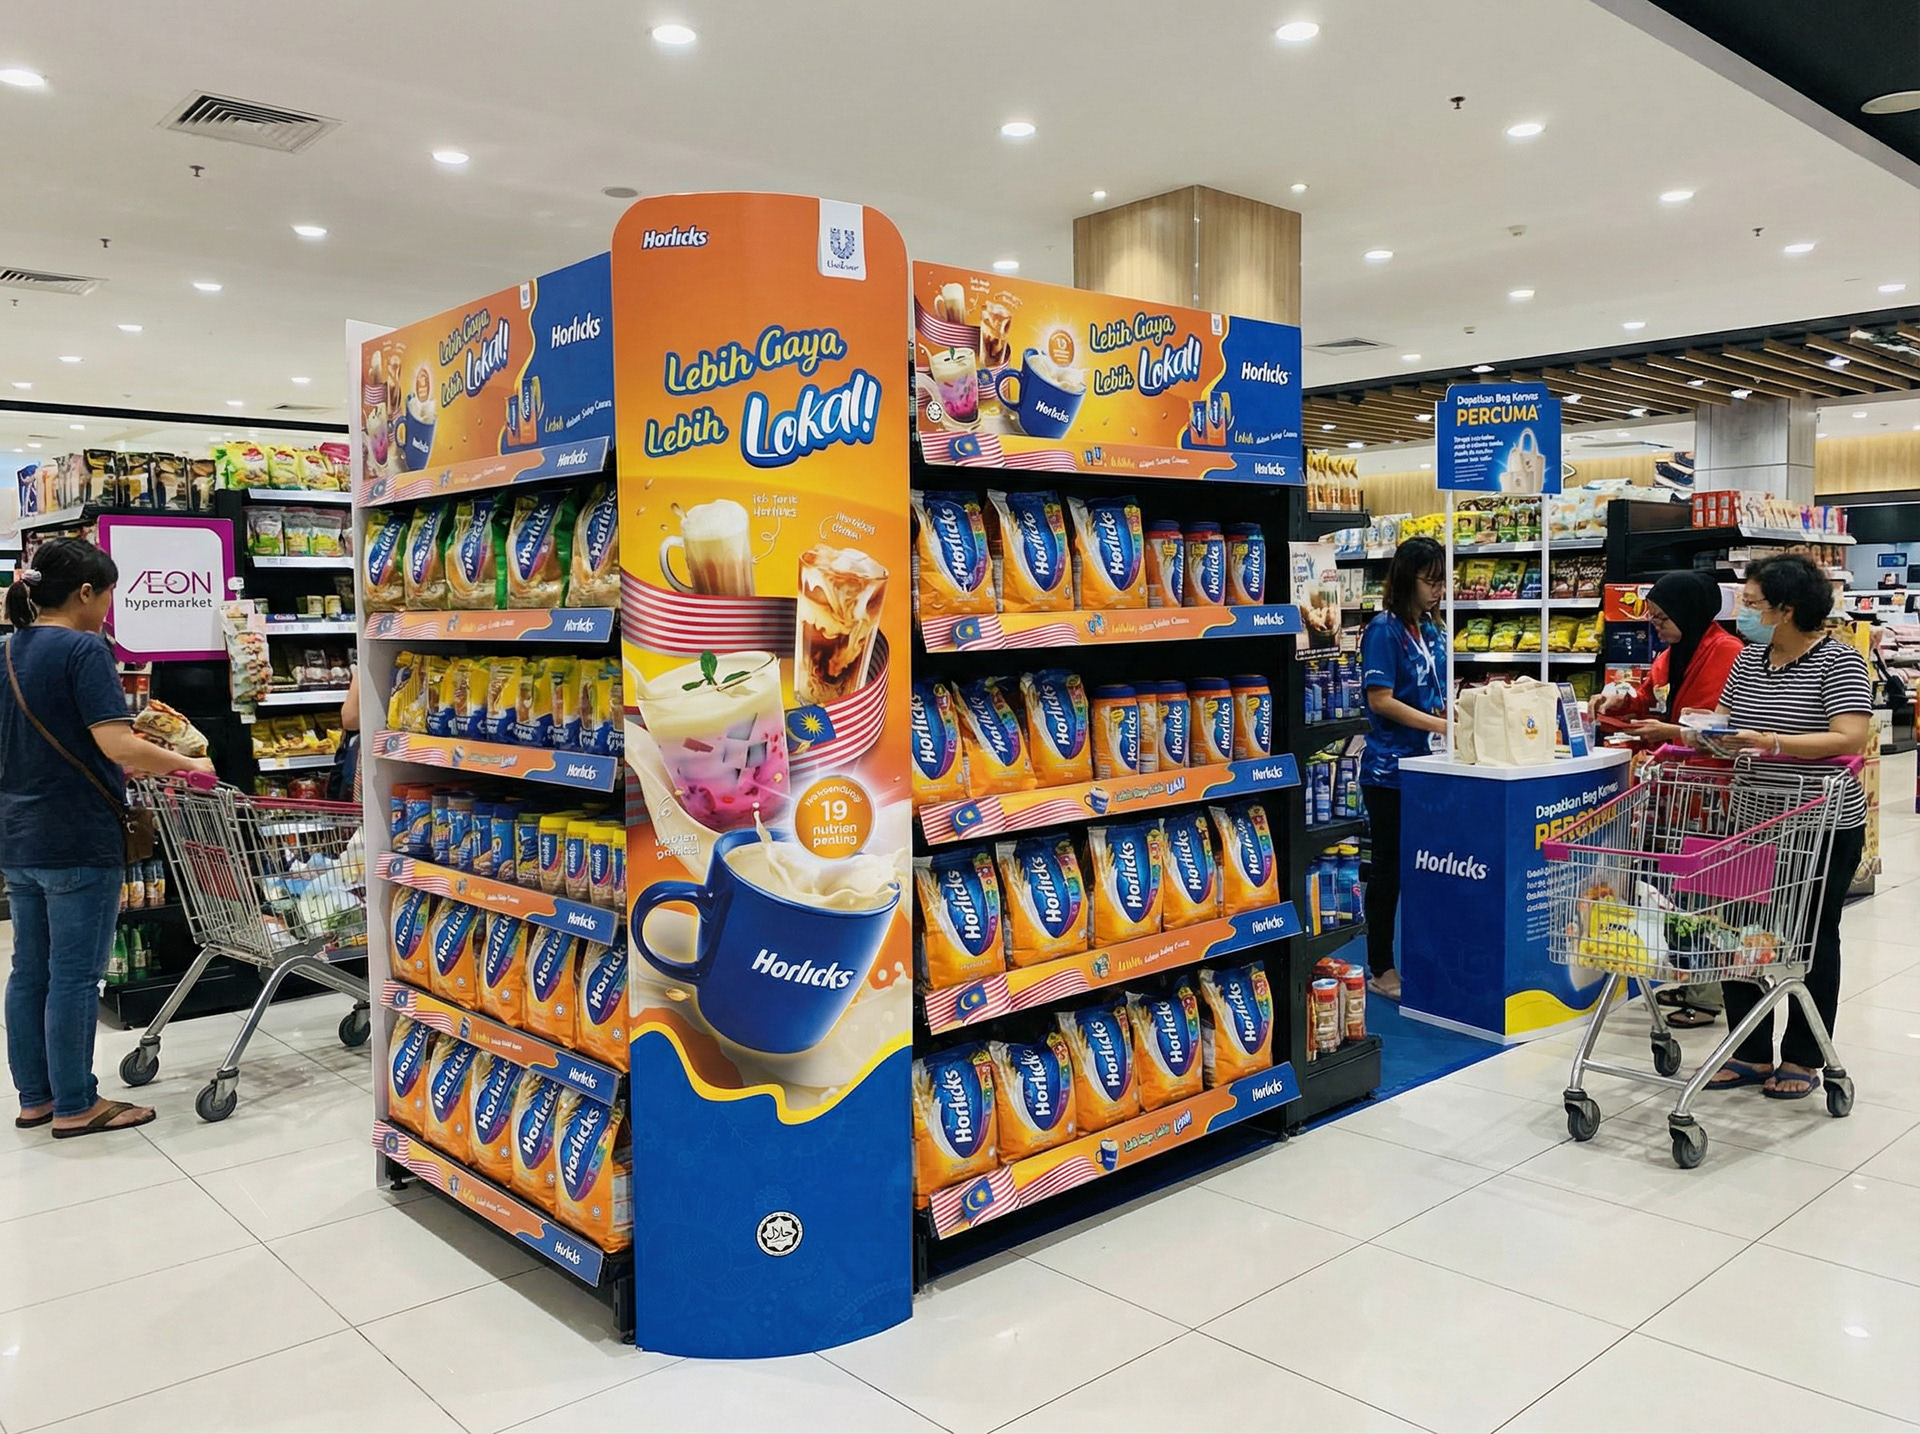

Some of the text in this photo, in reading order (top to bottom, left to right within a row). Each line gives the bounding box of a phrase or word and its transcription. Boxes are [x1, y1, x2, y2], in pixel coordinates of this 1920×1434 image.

[642, 226, 708, 249] Horlicks
[466, 319, 509, 390] Lokal!
[551, 312, 601, 350] Horlicks
[668, 329, 843, 391] Lebih Gaya
[1091, 322, 1133, 350] Lebih
[1134, 313, 1175, 344] Gaya
[1096, 335, 1201, 393] Lebih Lokal!
[1240, 361, 1290, 385] Horlicks
[647, 373, 878, 458] Lebih Lokal!
[1456, 404, 1539, 427] PERCUMA
[941, 508, 968, 577] Horlicks
[1022, 510, 1050, 575] Horlicks
[1098, 511, 1125, 576] Horlicks
[124, 597, 213, 611] hypermarket
[1042, 684, 1070, 745] Horlicks
[812, 823, 857, 835] nutrien
[812, 835, 857, 848] penting
[820, 800, 849, 822] 19
[1031, 856, 1062, 923] Horlicks
[1118, 841, 1143, 908] Horlicks
[1173, 829, 1202, 890] Horlicks
[1415, 849, 1488, 880] Horlicks
[947, 870, 982, 939] Horlicks
[751, 949, 855, 990] Horlicks
[1228, 982, 1257, 1042] Horlicks
[1091, 1021, 1121, 1088] Horlicks
[942, 1069, 973, 1143] Horlicks
[564, 1107, 600, 1185] Horlicks
